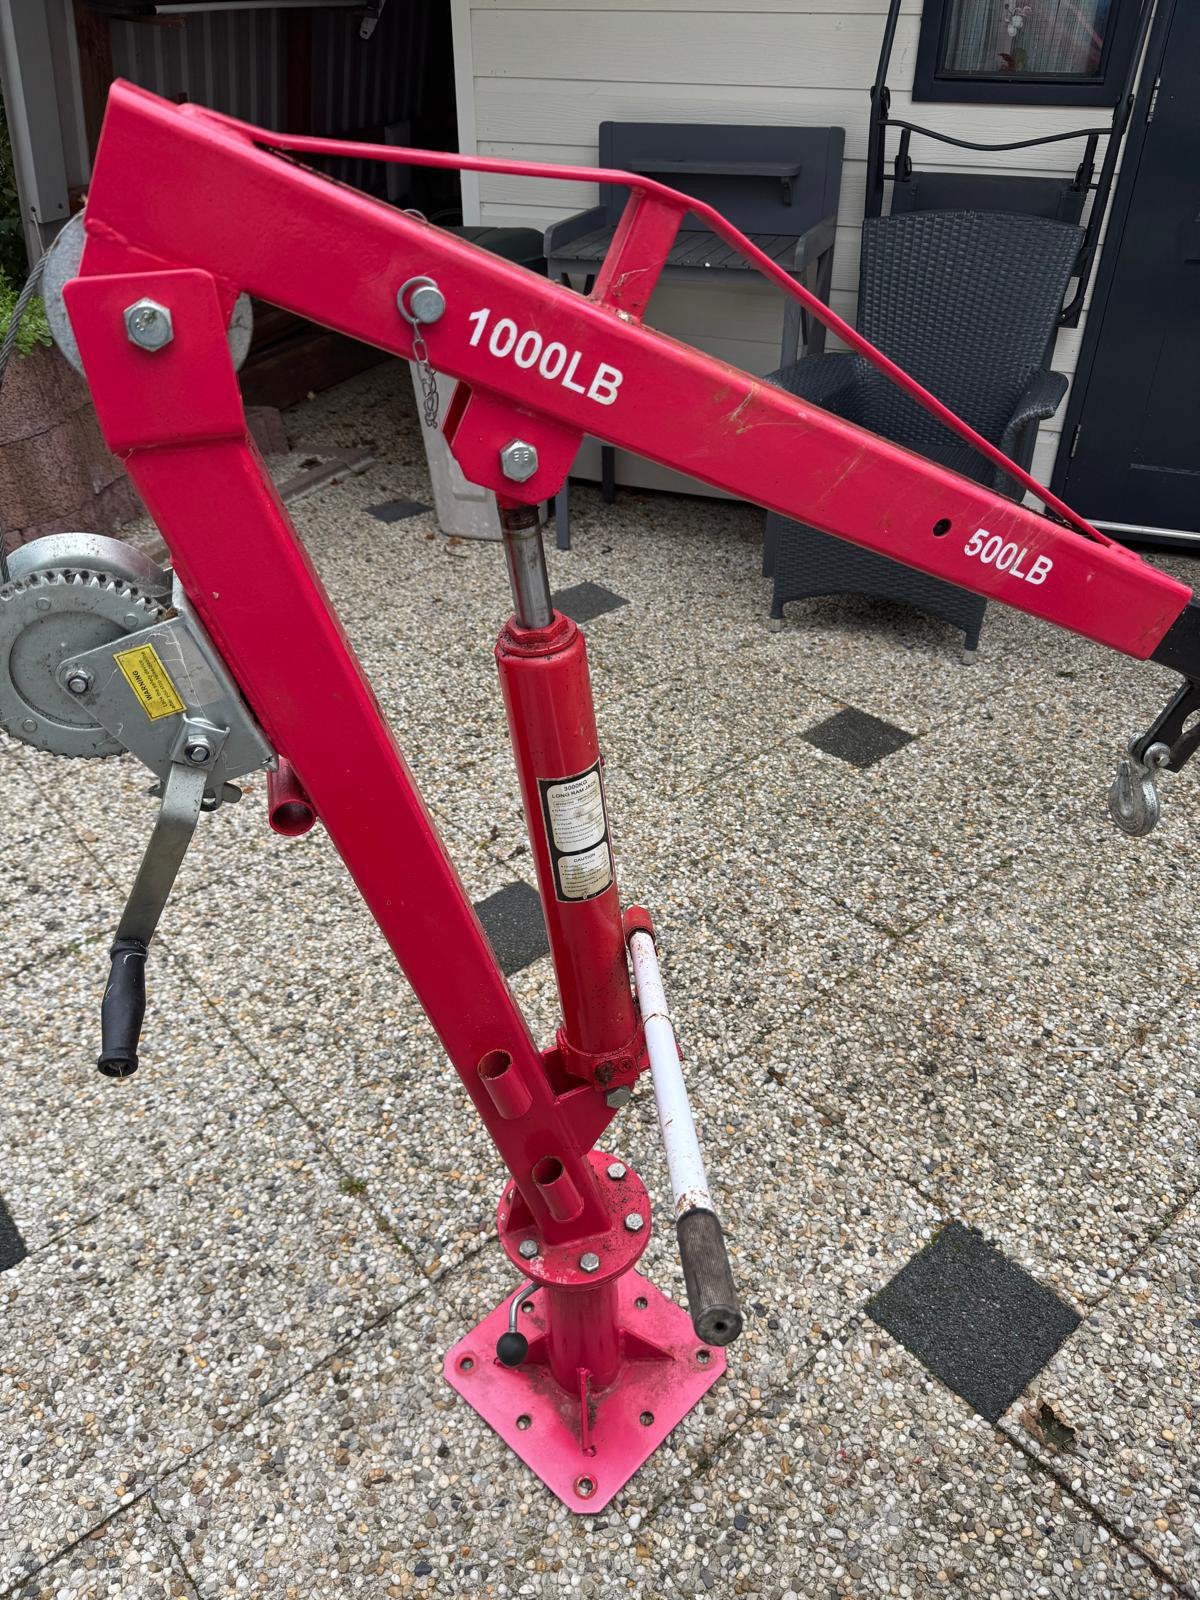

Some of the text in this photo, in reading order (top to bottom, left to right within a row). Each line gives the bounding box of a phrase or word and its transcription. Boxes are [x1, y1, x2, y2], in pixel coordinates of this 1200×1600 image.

[469, 308, 624, 406] 1000LB
[964, 528, 1053, 585] 500LB
[132, 670, 153, 701] WARNING
[571, 788, 584, 797] RAM
[573, 853, 596, 863] CAUTION
